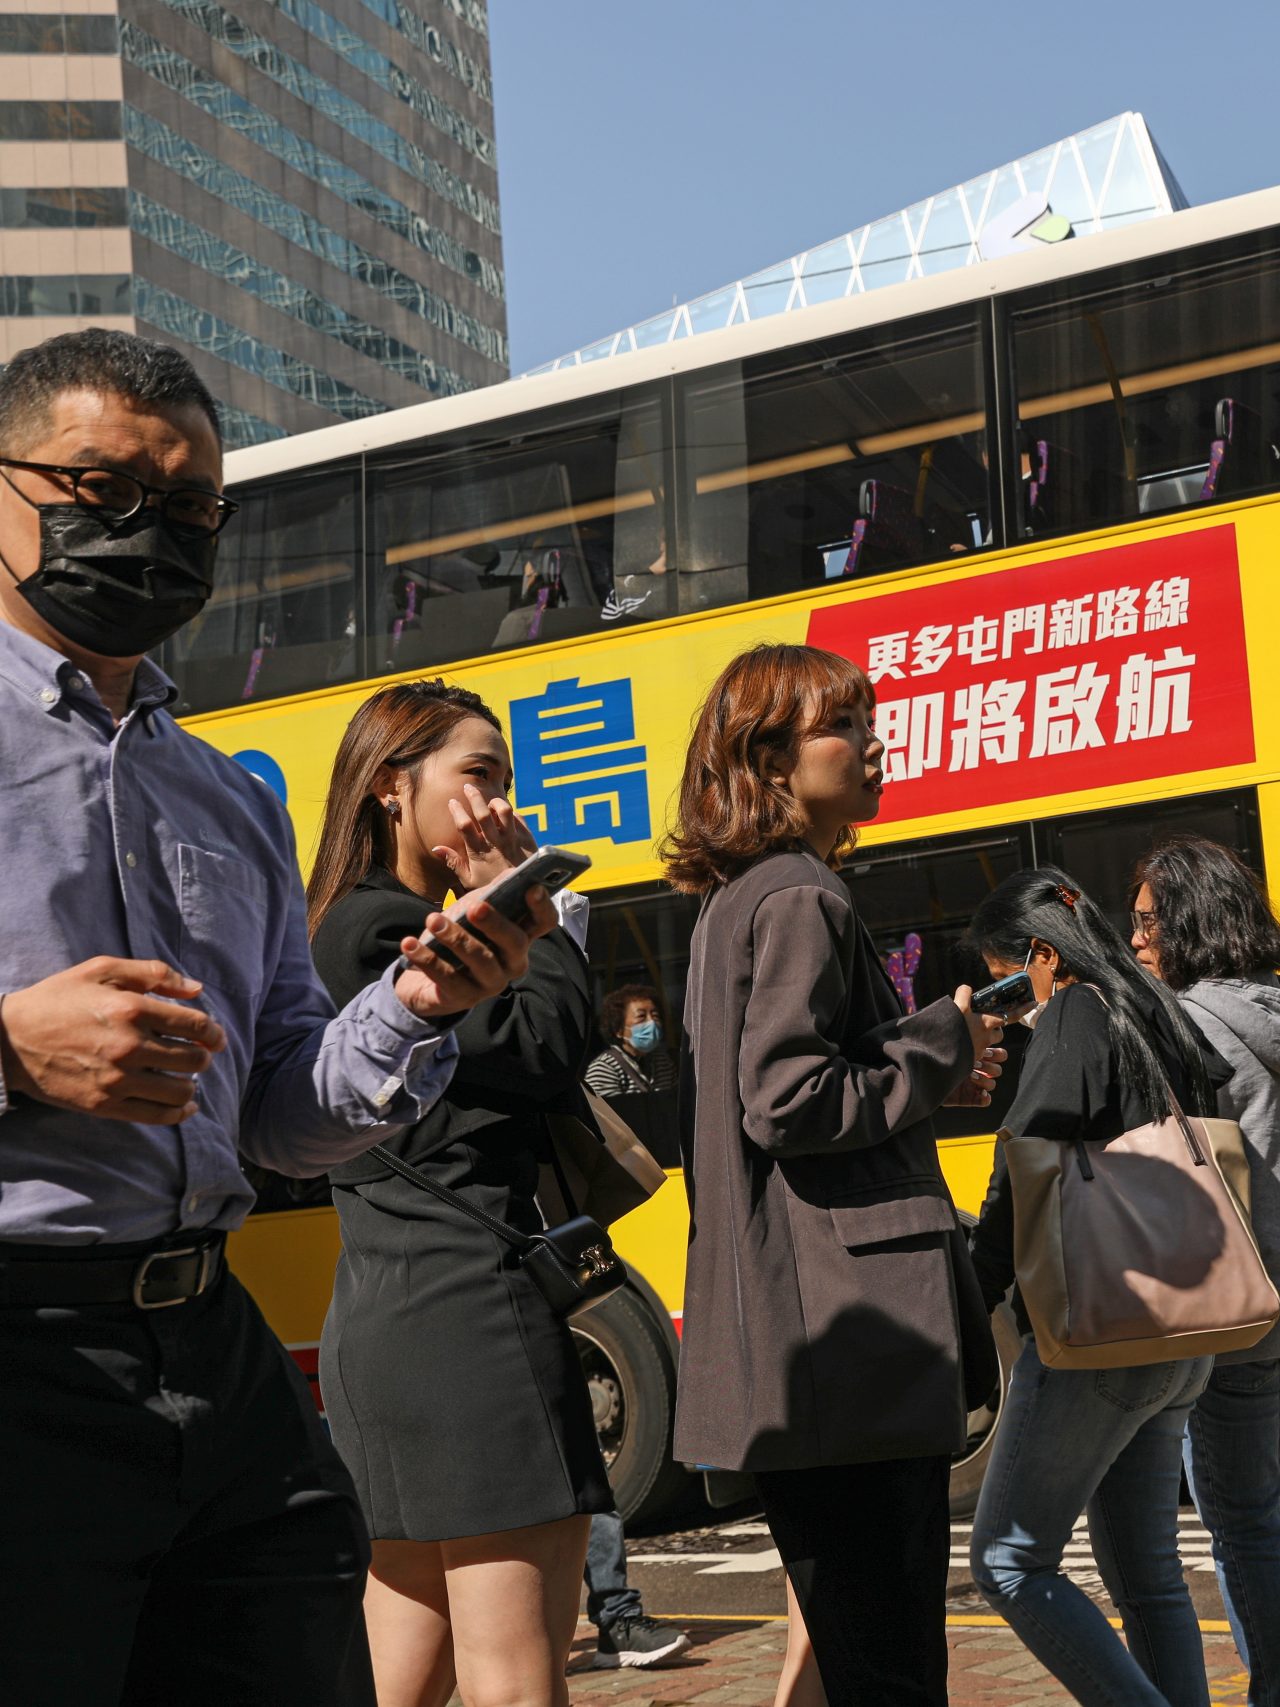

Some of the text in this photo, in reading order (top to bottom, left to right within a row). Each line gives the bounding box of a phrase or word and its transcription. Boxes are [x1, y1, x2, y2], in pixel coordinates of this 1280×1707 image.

[867, 575, 1191, 684] 更多屯門新路線
[509, 677, 652, 845] 島
[873, 646, 1196, 783] 即將啟航
